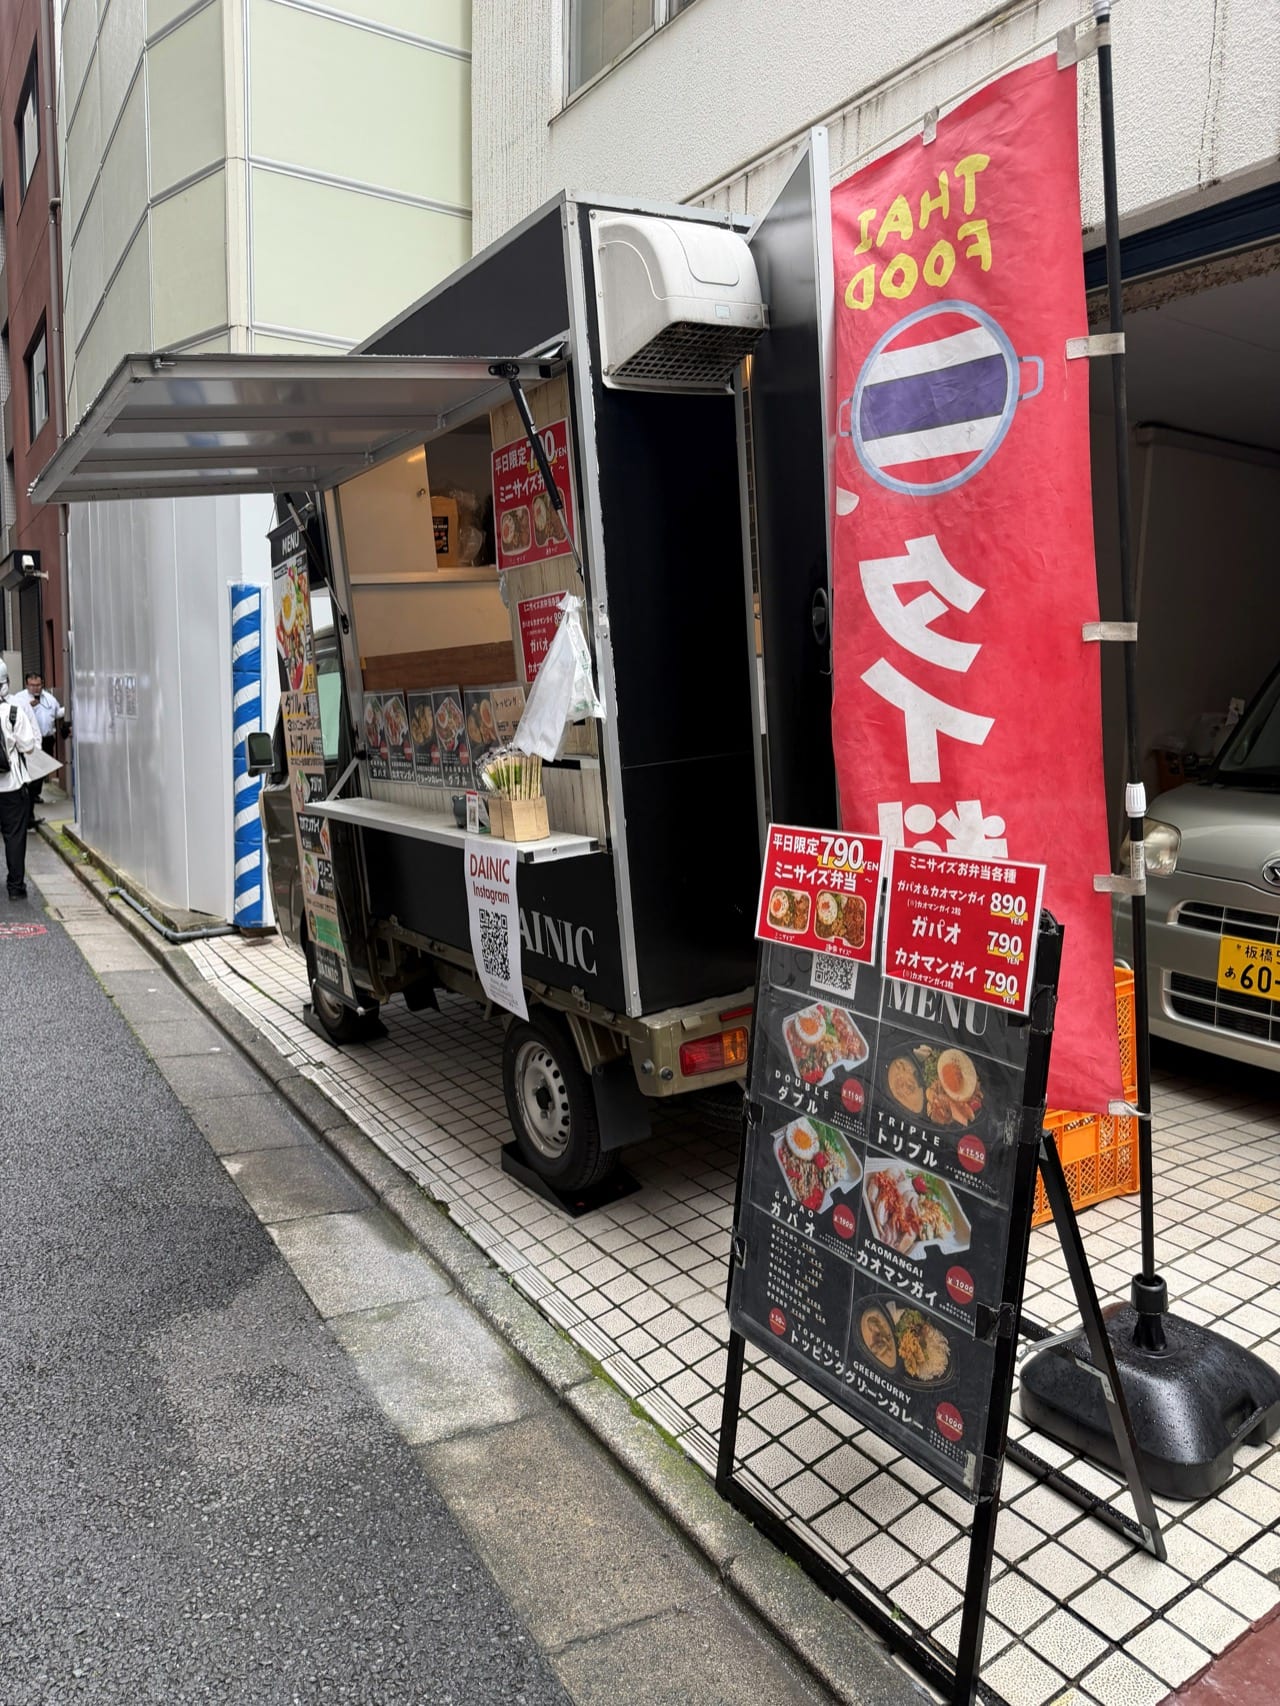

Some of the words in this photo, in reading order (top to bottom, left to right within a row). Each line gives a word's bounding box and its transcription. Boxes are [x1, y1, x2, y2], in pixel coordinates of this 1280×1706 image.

[526, 430, 555, 469] 70
[500, 466, 554, 503] ミニサイズ弁
[282, 530, 300, 556] MENU
[469, 853, 511, 884] DAINIC
[773, 833, 820, 856] 平日限定
[820, 836, 864, 870] 790
[862, 861, 879, 871] YEN
[909, 856, 1017, 884] ミニサイズお弁当各種
[473, 881, 510, 905] Instagram
[775, 861, 857, 892] ミニサイズ弁当
[897, 880, 986, 906] ガパオ&カオマンガイ
[990, 892, 1026, 916] 890
[1010, 917, 1024, 926] YEN
[912, 915, 962, 945] ガパオ
[987, 930, 1022, 956] 790
[1006, 957, 1020, 966] YEN
[1244, 944, 1273, 963] 板橋
[895, 947, 978, 984] カオマンガイ
[984, 969, 1018, 996] 790
[1002, 996, 1016, 1006] YEN
[1225, 964, 1236, 979] あ
[887, 978, 989, 1036] MENU
[775, 1069, 829, 1100] DOUBLE
[778, 1085, 819, 1114] ダブル
[877, 1128, 938, 1168] トリプル
[878, 1112, 941, 1147] TRIPLE
[774, 1191, 814, 1218] GAPAO
[864, 1239, 924, 1278] KAOMANGAI
[857, 1250, 938, 1306] カオマンガイ
[790, 1329, 846, 1374] トッピング
[797, 1325, 840, 1358] TOPPING
[845, 1371, 924, 1431] グリーンカレー
[853, 1360, 912, 1405] GREENCURRY
